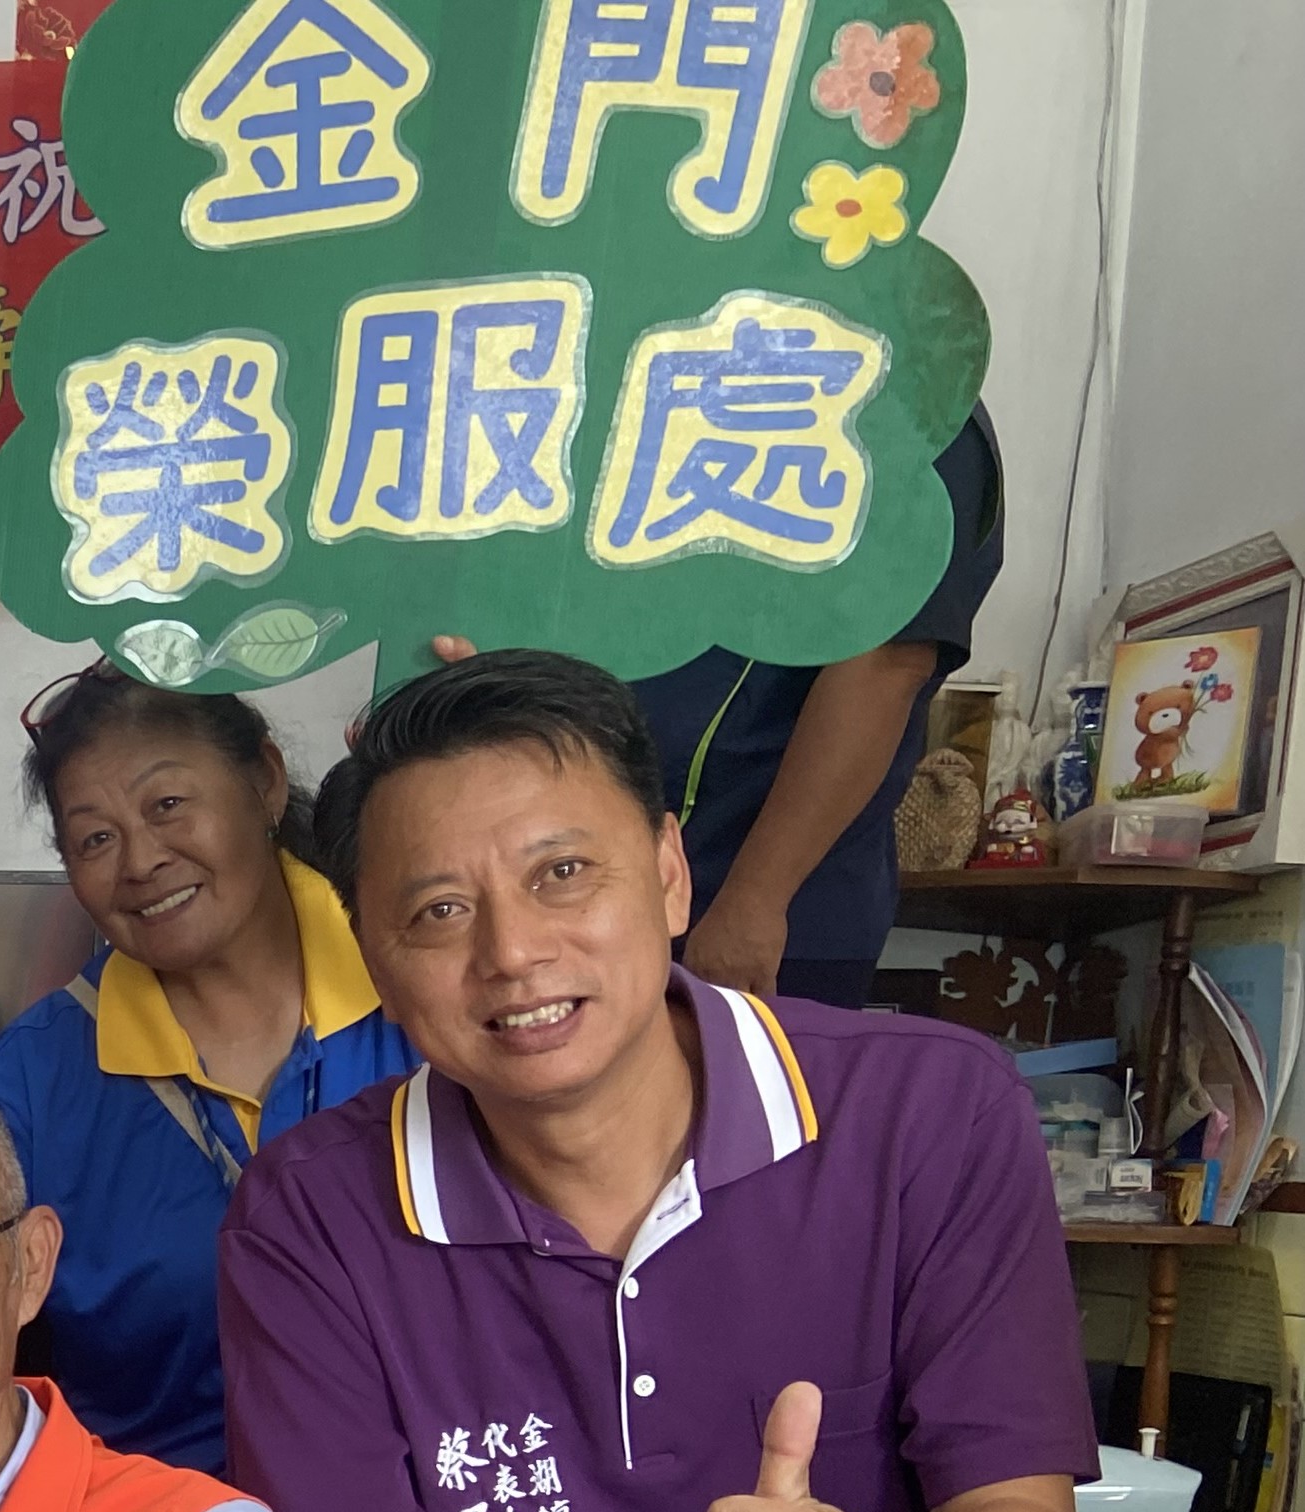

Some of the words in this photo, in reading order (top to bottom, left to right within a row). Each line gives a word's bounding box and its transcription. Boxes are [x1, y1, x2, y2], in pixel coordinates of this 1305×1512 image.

[201, 0, 788, 222] 金門
[72, 299, 863, 577] 榮服處
